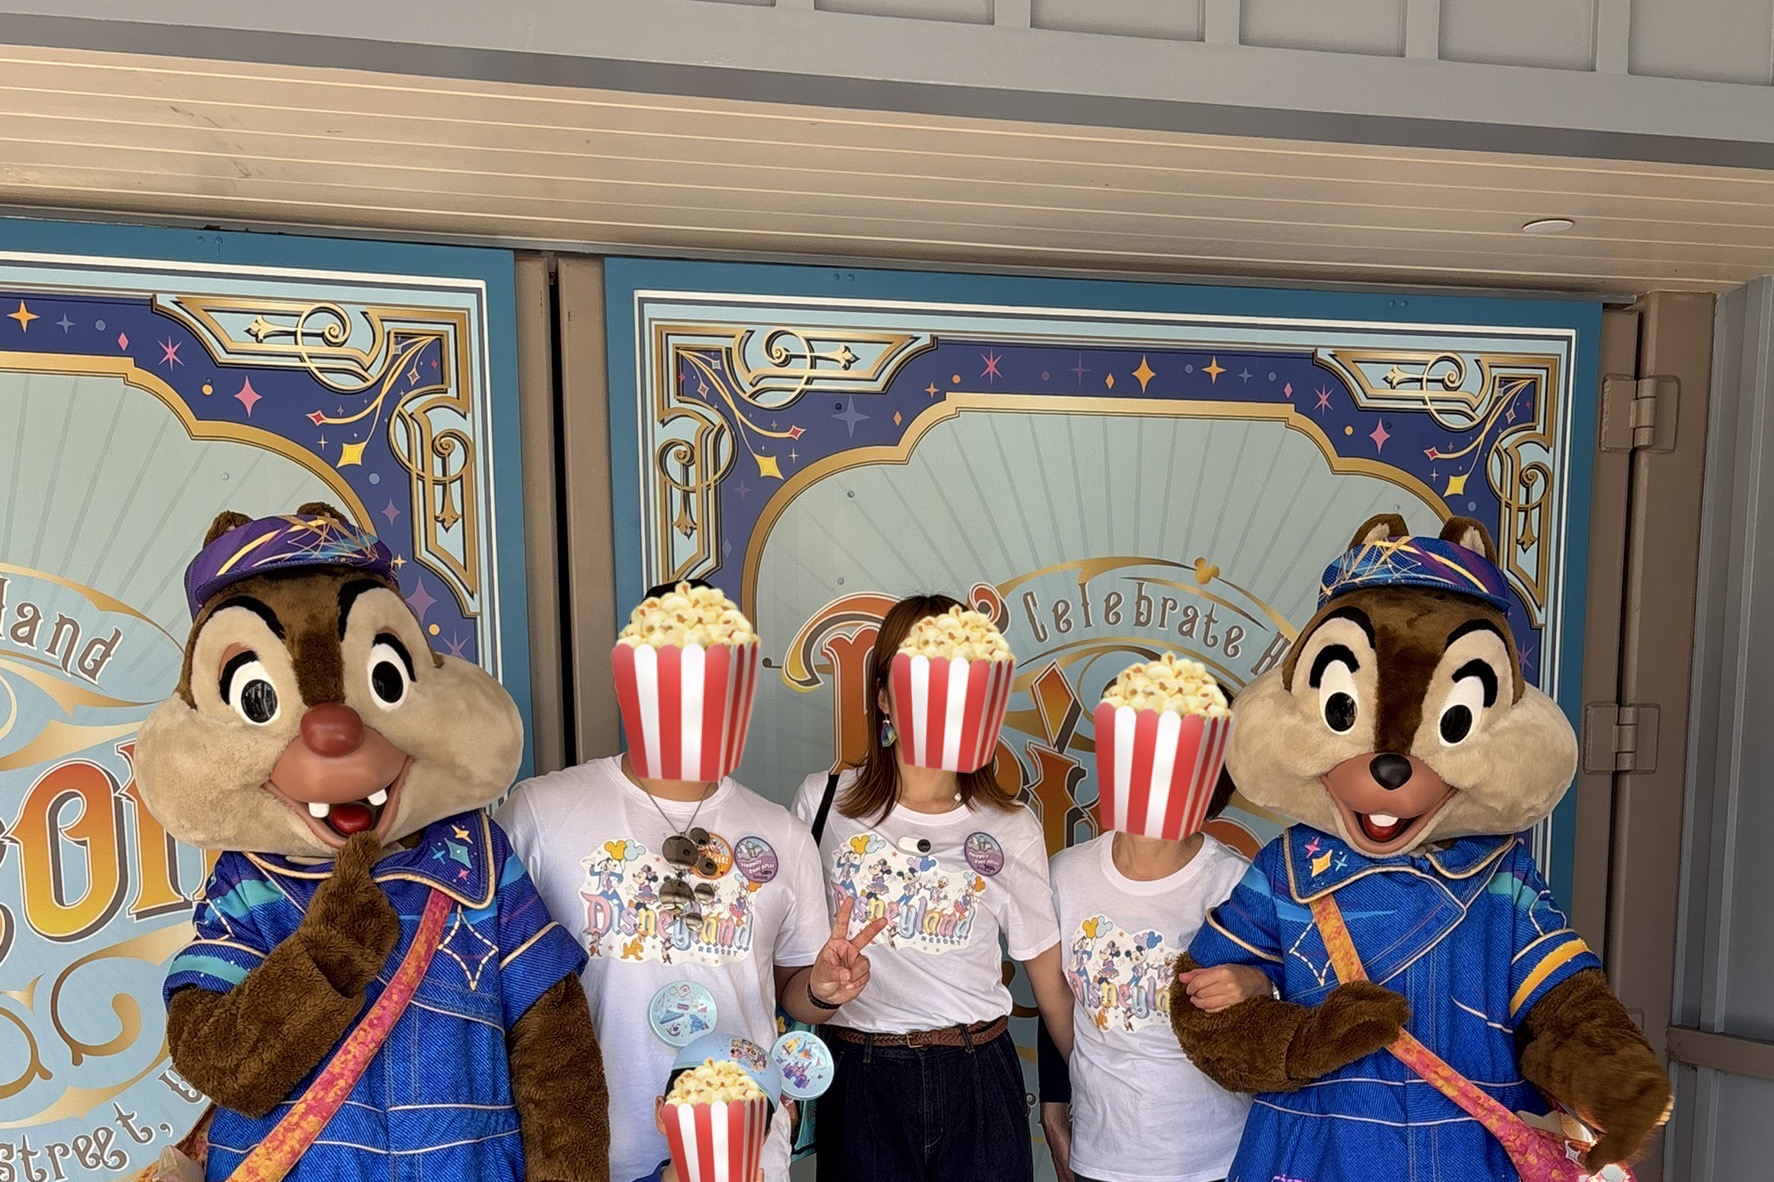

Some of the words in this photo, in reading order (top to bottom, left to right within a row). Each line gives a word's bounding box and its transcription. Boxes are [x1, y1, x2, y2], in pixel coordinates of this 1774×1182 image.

[1022, 582, 1246, 659] Celebrate
[921, 936, 961, 946] RESORT
[698, 946, 738, 957] RESORT
